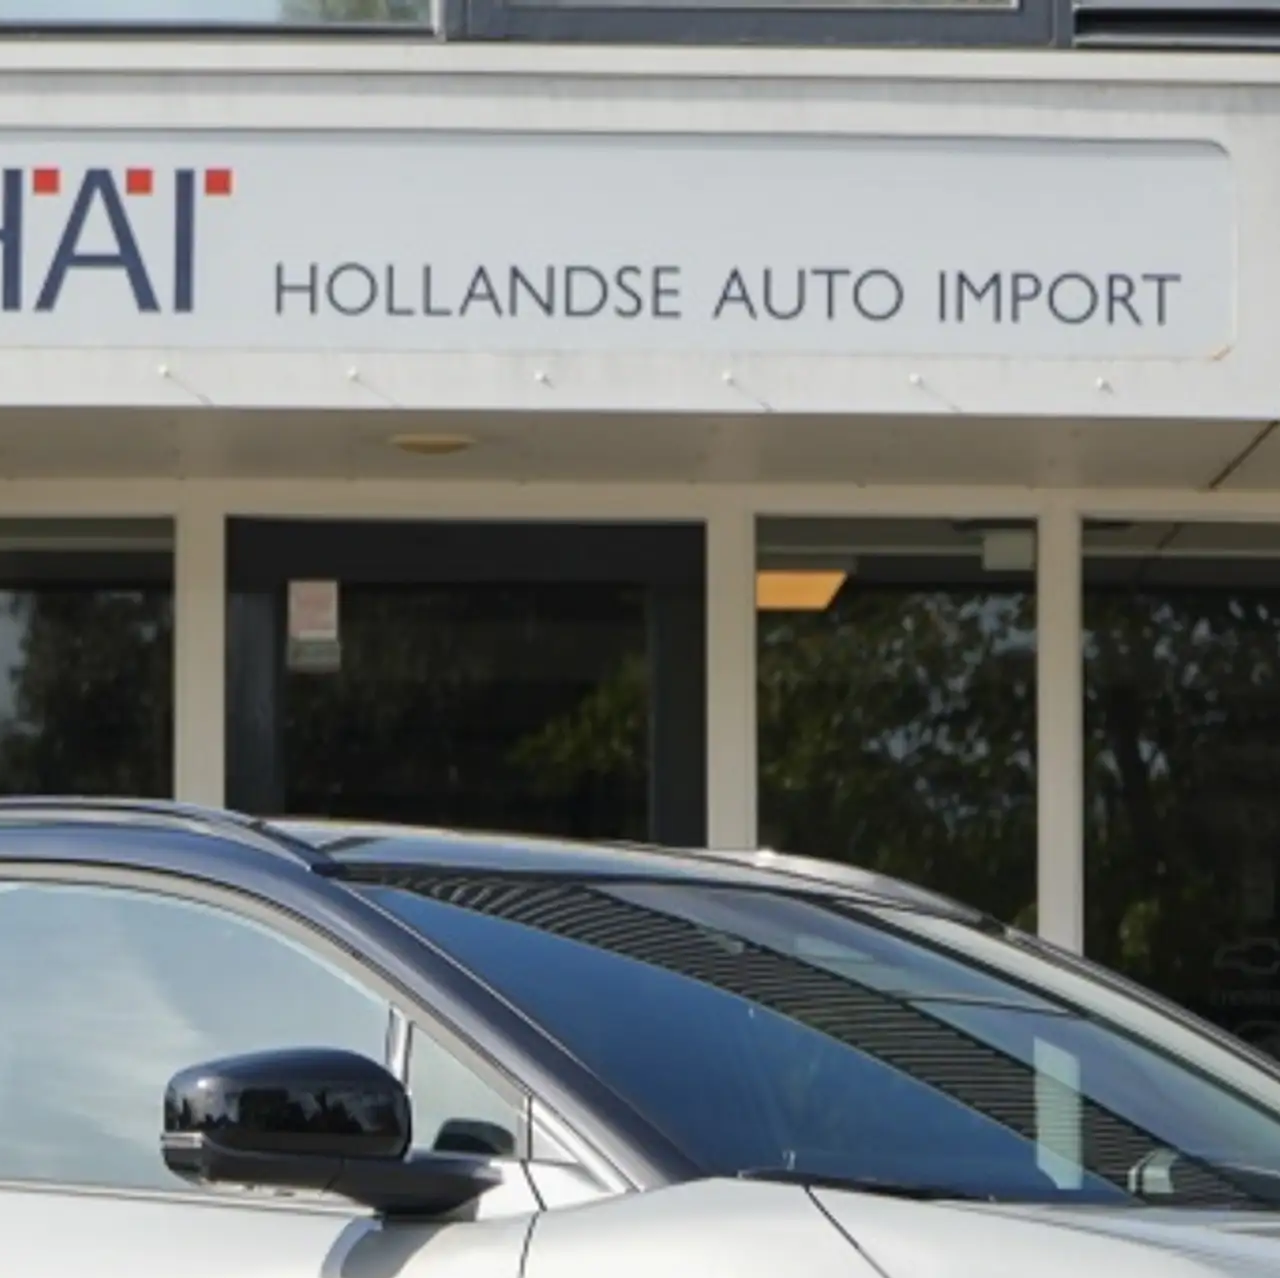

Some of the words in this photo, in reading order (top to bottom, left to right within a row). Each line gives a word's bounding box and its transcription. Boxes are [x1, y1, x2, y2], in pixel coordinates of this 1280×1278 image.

[275, 261, 682, 319] HOLLANDSE
[712, 266, 905, 321] AUTO
[938, 269, 1183, 326] IMPORT
